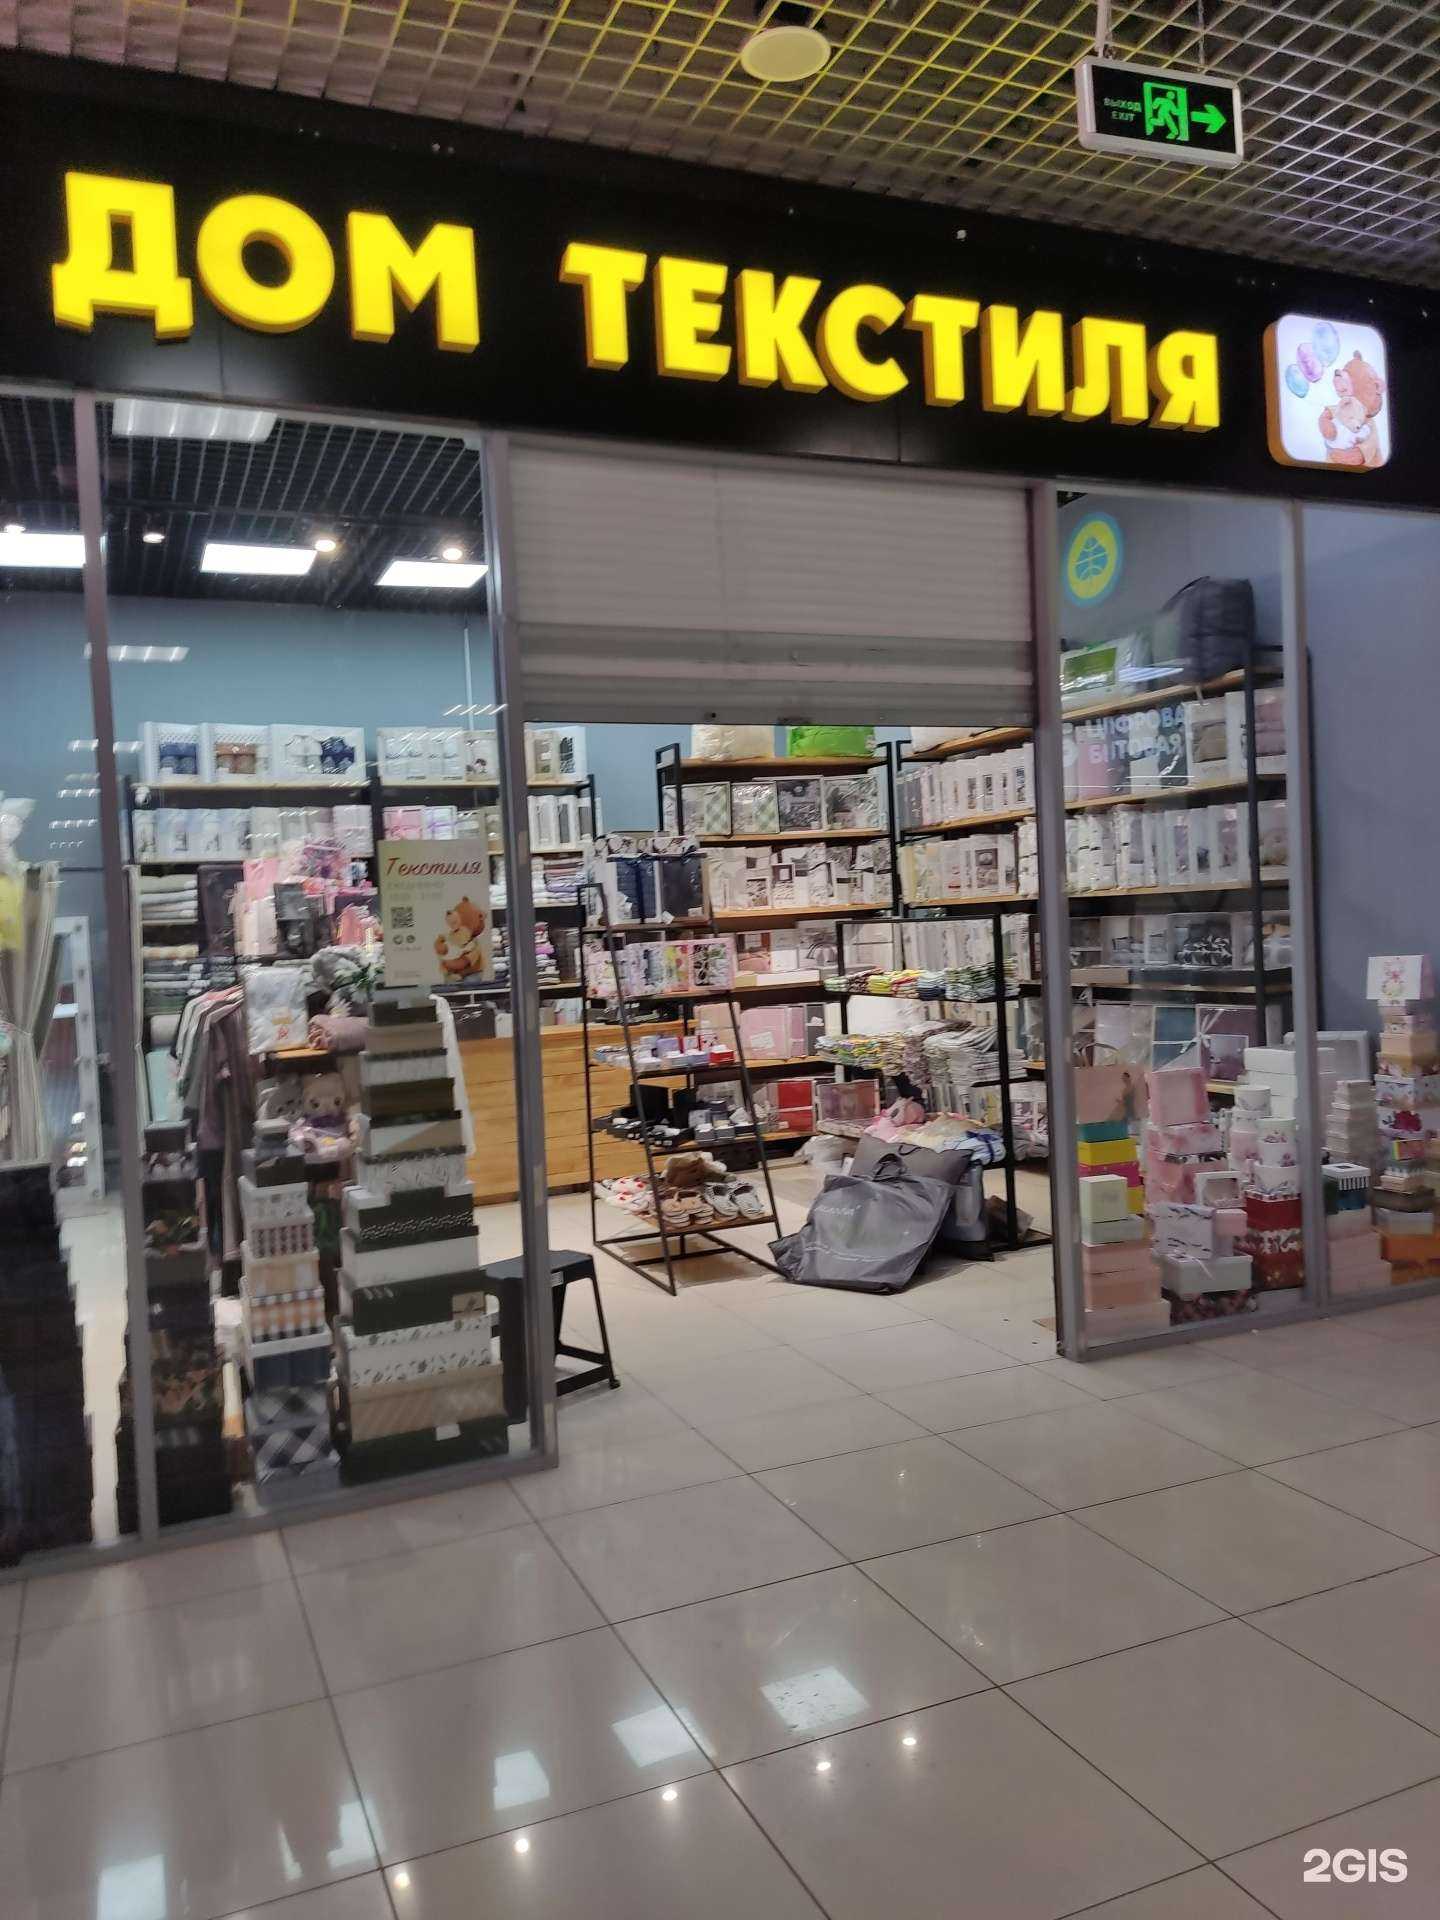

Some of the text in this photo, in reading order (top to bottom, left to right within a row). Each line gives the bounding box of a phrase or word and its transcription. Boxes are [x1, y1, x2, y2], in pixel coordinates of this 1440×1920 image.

[1111, 111, 1136, 122] EXIT
[51, 170, 1221, 432] ДОМ ТЕКСТИЛЯ
[386, 857, 484, 876] Текстиля
